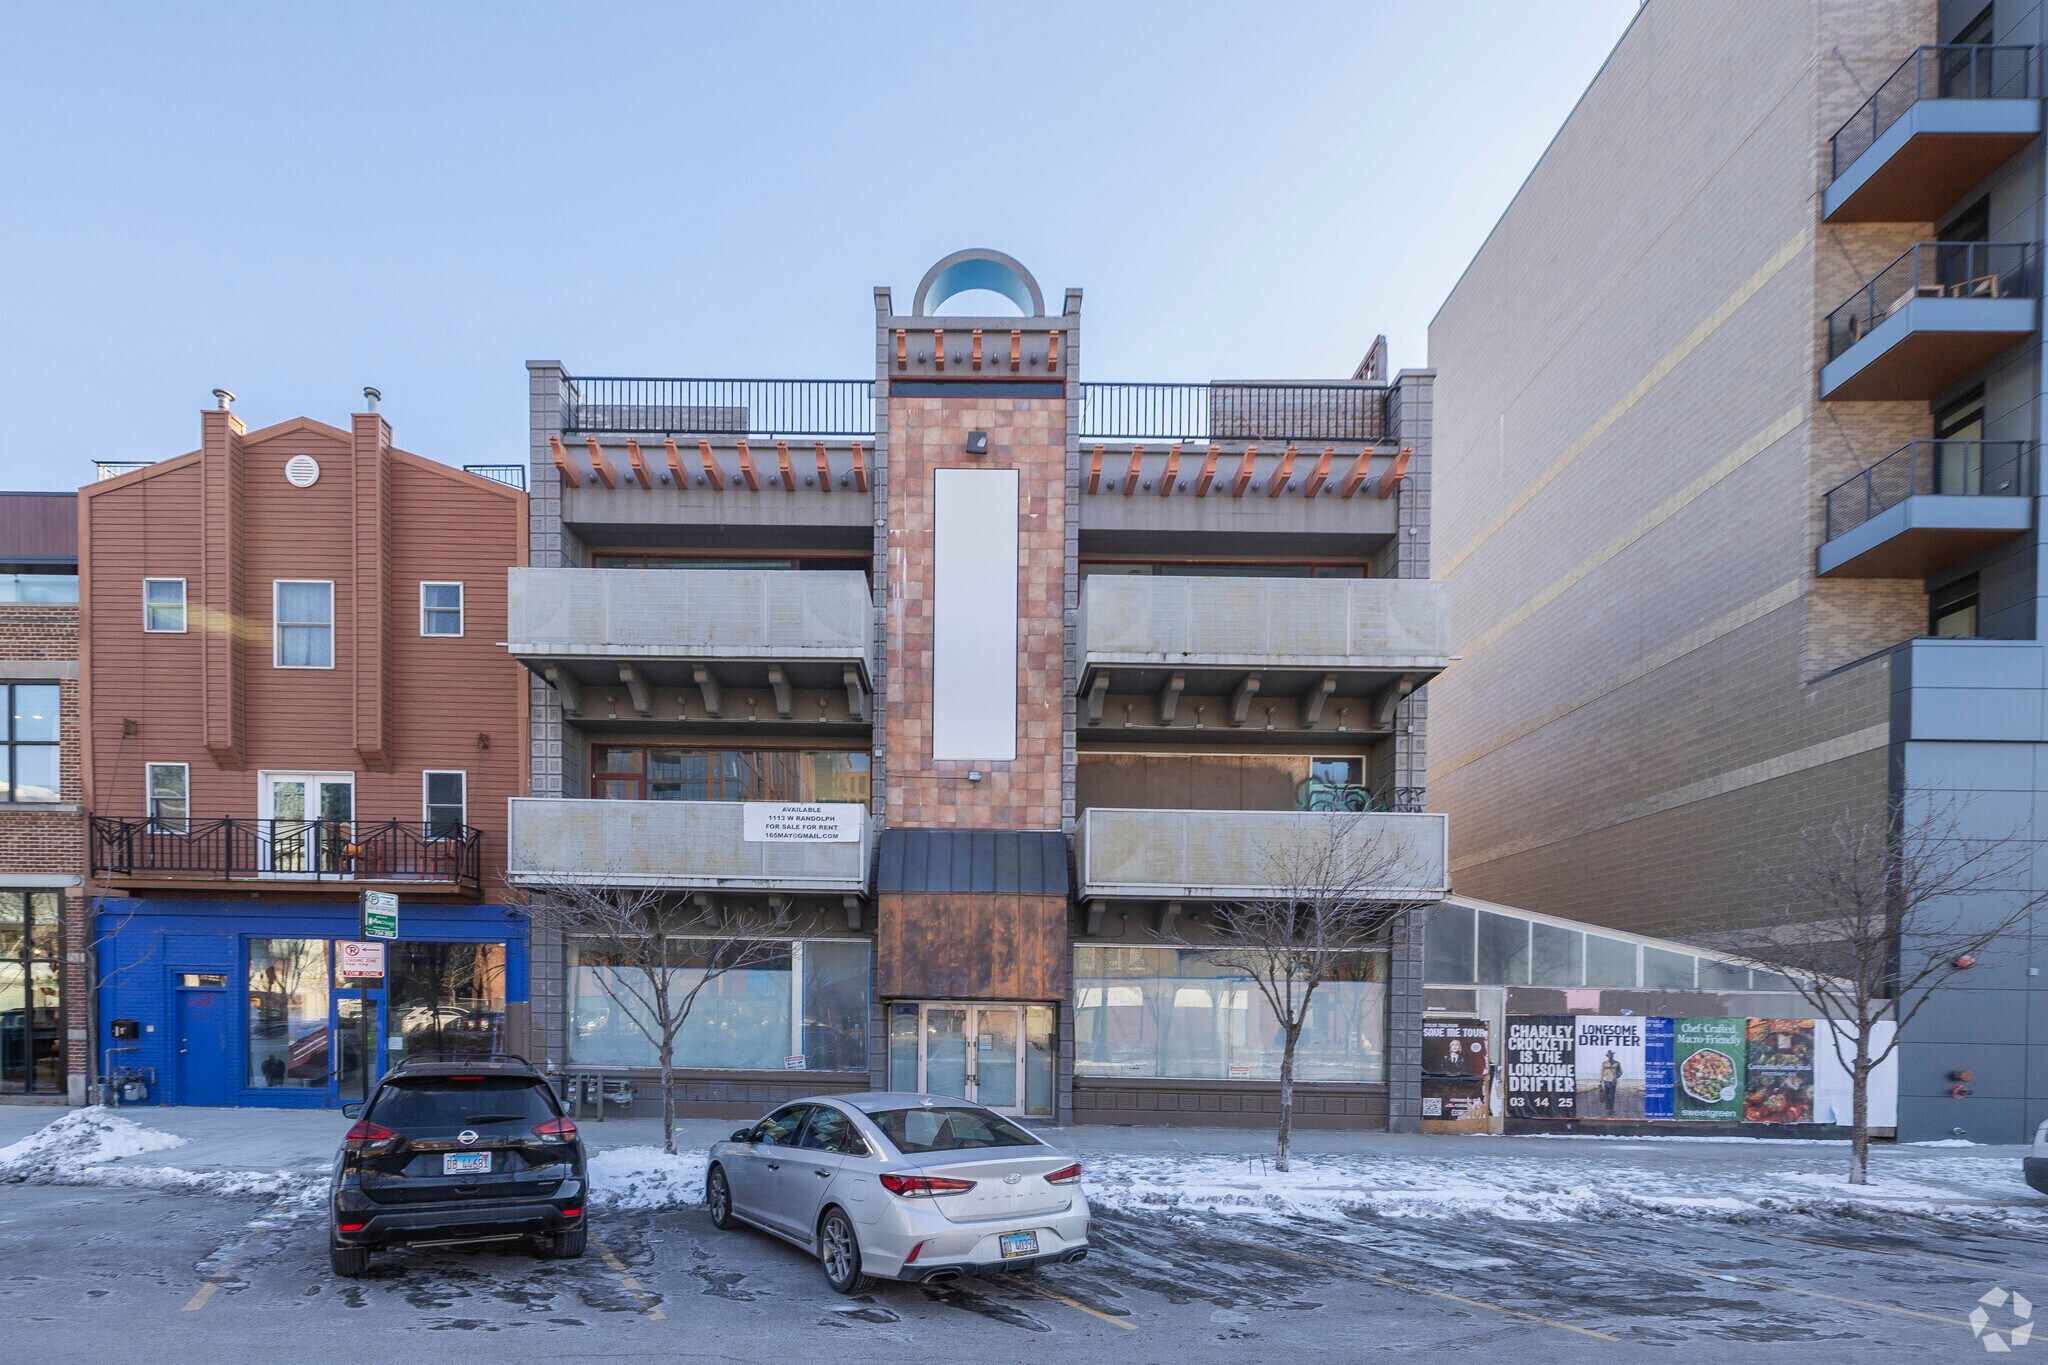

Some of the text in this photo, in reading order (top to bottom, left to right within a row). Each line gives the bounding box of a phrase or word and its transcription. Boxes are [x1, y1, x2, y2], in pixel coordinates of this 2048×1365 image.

[1423, 1028, 1485, 1038] SAVE ME TOUR
[1510, 1024, 1573, 1038] CHARLEY
[1582, 1024, 1637, 1035] LONESOME
[1508, 1038, 1574, 1051] CROCKETT
[1579, 1035, 1640, 1047] DRIFTER
[1677, 1034, 1741, 1046] Macro-Friendly
[1520, 1051, 1562, 1063] IS THE
[1508, 1064, 1574, 1077] LONESOME
[1509, 1077, 1574, 1092] DRIFTER
[1510, 1097, 1573, 1107] 03 14 25
[1681, 1109, 1736, 1119] sweetgreen
[462, 1158, 489, 1169] 44681
